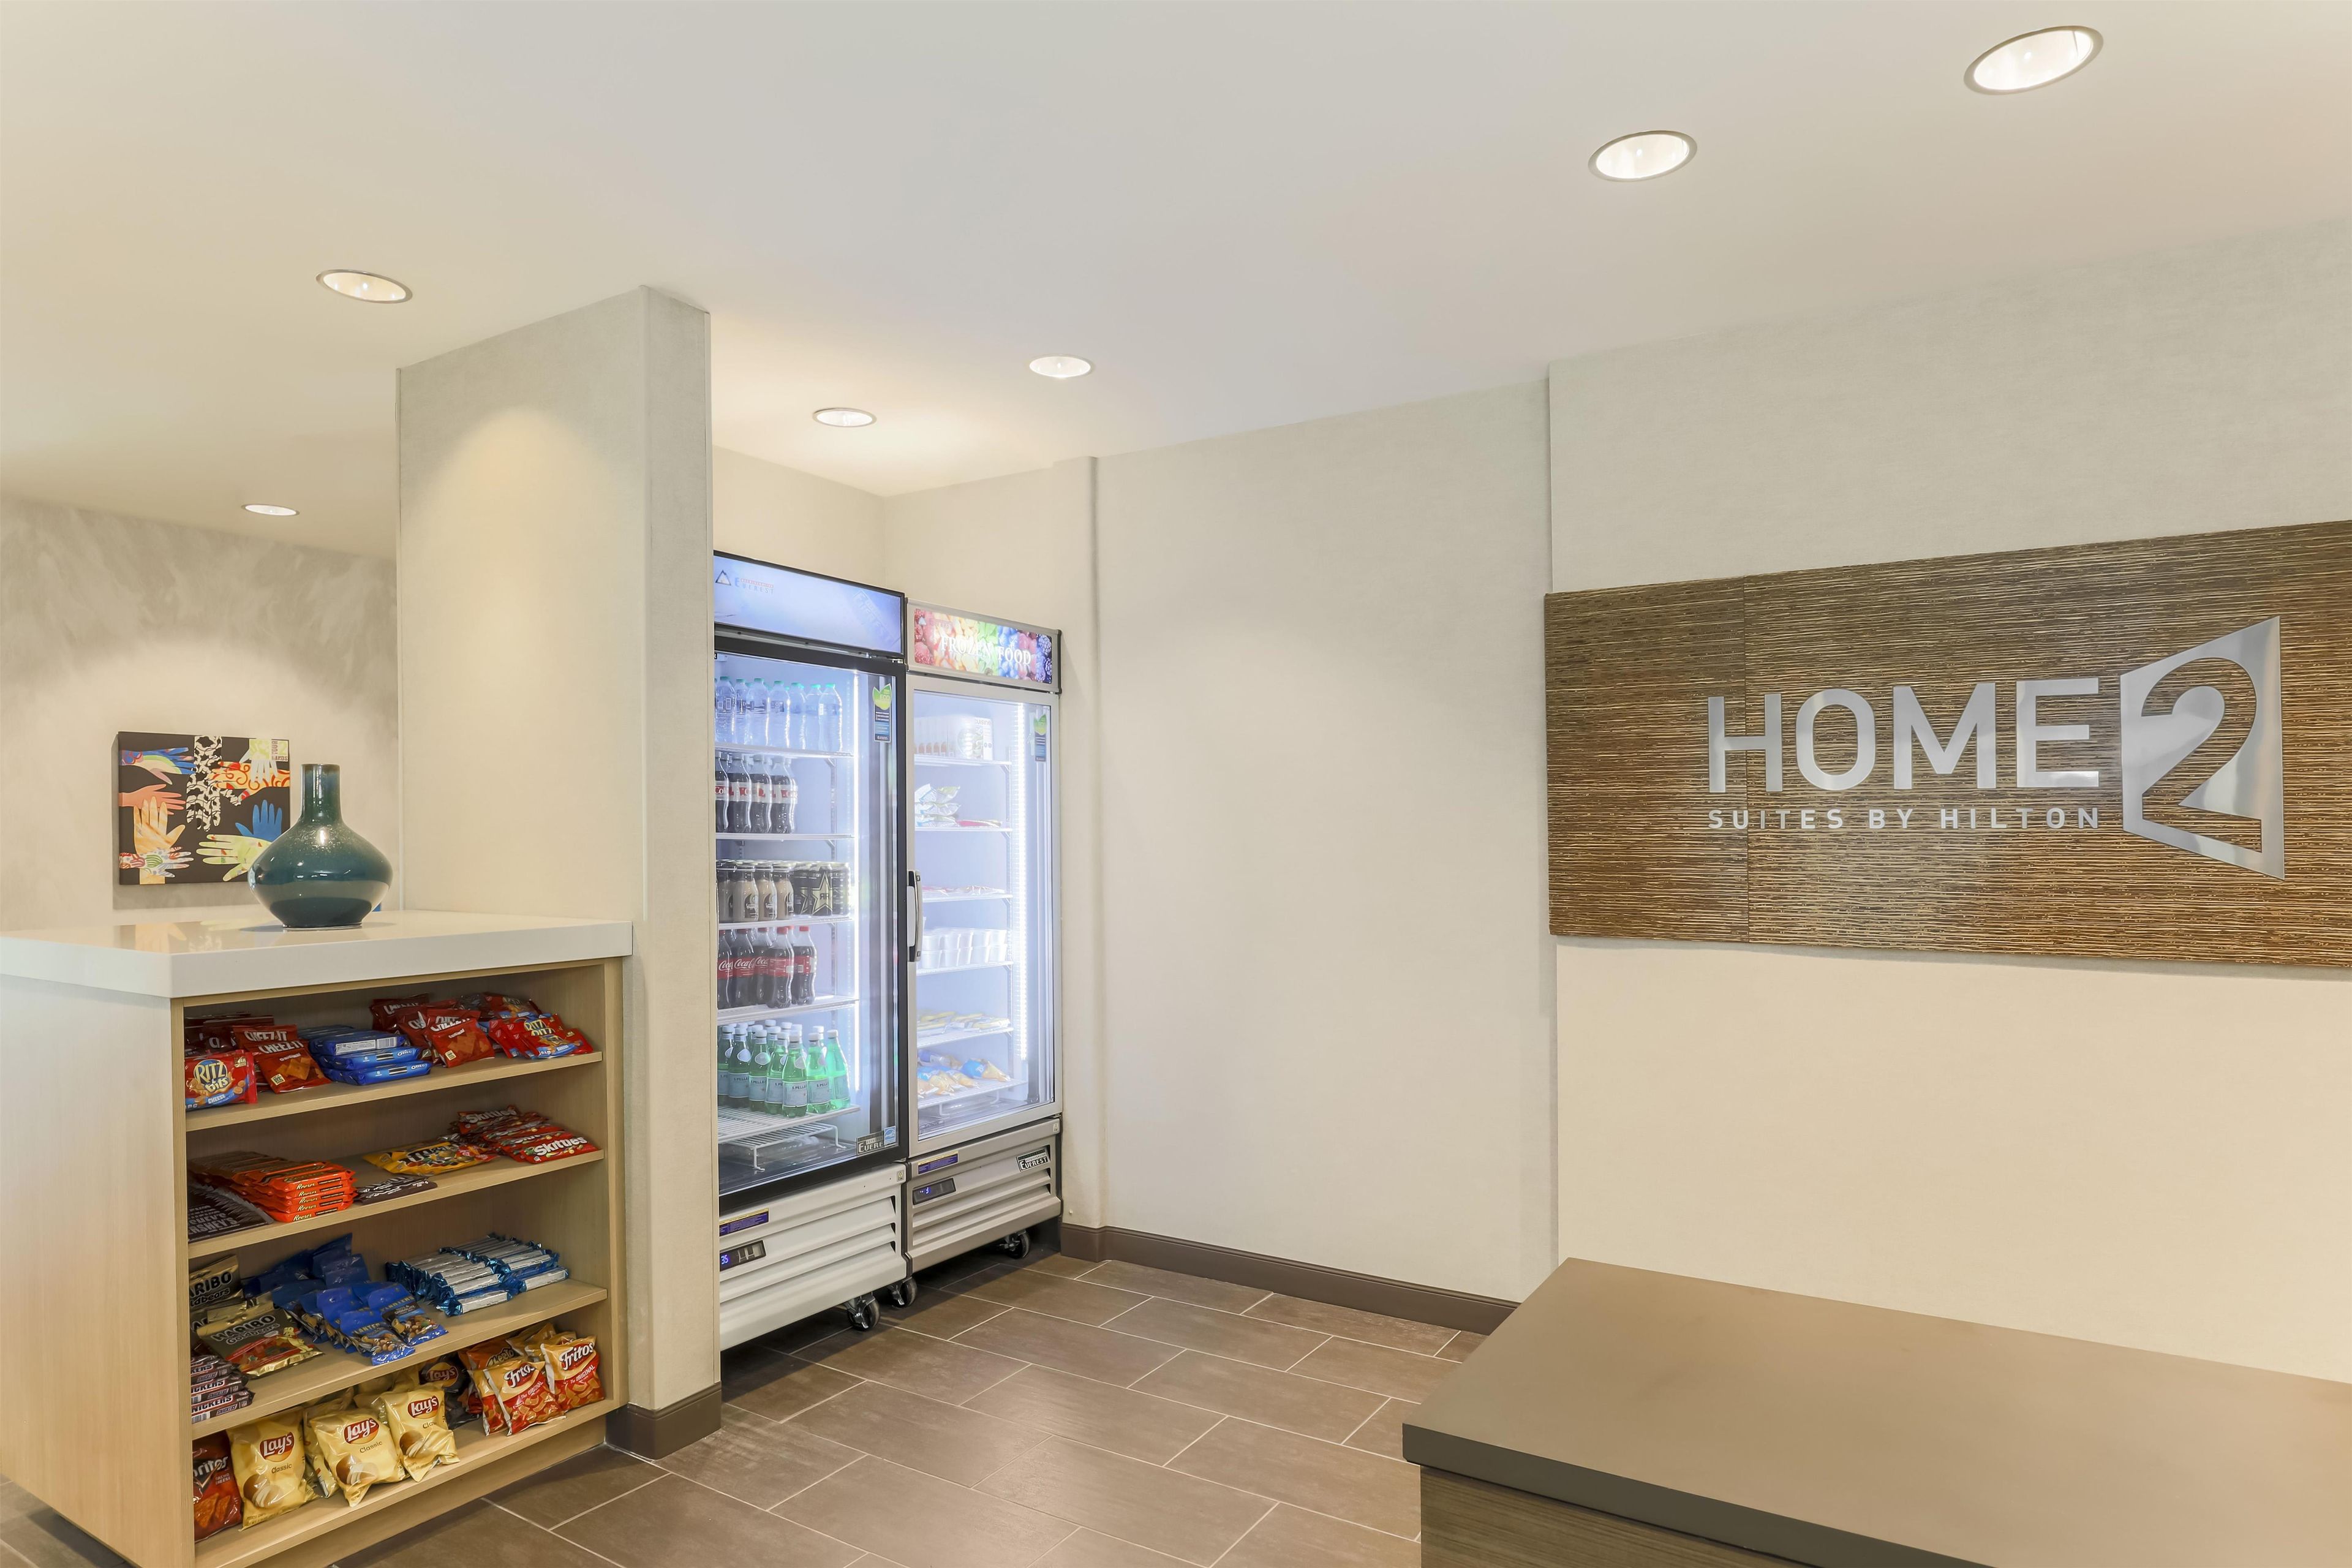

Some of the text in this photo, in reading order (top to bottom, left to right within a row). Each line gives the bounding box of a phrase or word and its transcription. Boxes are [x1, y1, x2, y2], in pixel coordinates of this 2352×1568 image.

[940, 635, 1031, 665] FROZEN FOOD
[1708, 655, 2264, 856] HOME 2
[1708, 807, 2098, 830] SUITES BY HILTON
[195, 1062, 225, 1085] RITZ
[205, 1077, 228, 1093] bits
[534, 1137, 587, 1156] Skittles
[1020, 1156, 1047, 1170] EVEREST
[721, 1254, 729, 1264] 35
[211, 1315, 276, 1341] HARIBO
[226, 1324, 281, 1345] Goldbears
[558, 1342, 594, 1371] Fritos
[575, 1364, 596, 1382] ORIGINAL
[411, 1396, 438, 1417] Lay's
[346, 1418, 377, 1442] Lay's
[263, 1434, 292, 1457] Lay's
[359, 1440, 383, 1453] Classic
[271, 1463, 292, 1474] Classic
